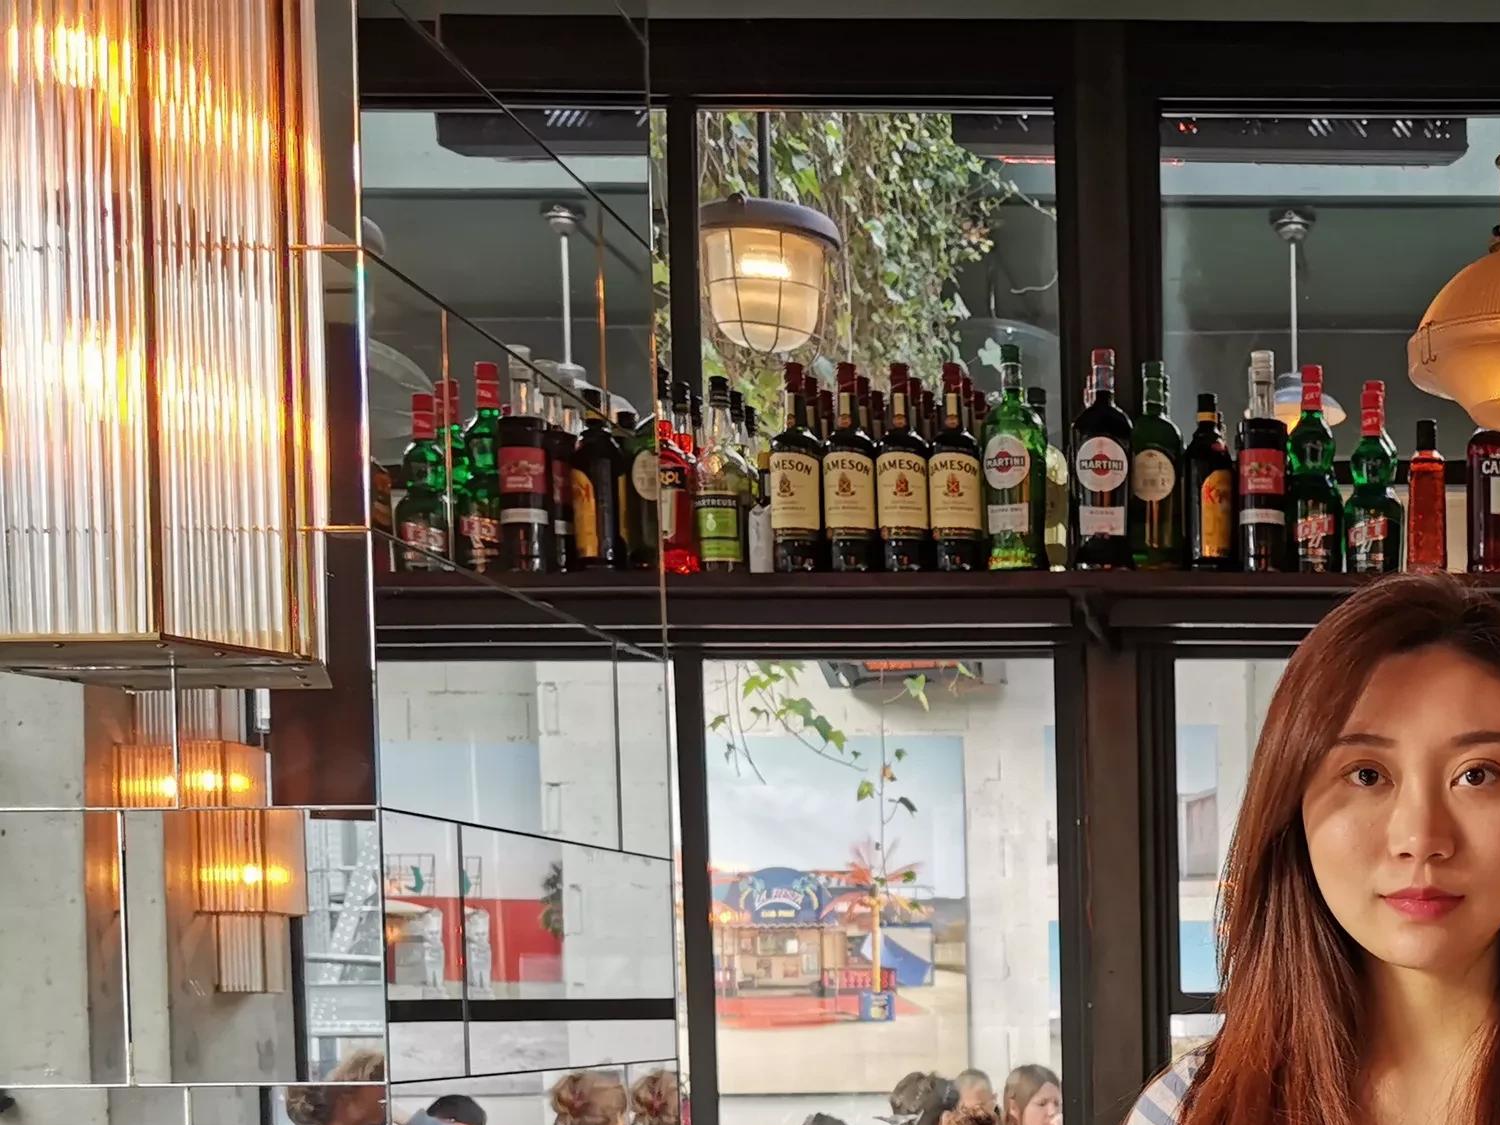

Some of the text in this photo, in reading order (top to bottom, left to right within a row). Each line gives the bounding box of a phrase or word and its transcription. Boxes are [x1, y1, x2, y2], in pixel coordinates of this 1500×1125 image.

[878, 459, 926, 477] JAMESON
[930, 459, 978, 477] JAMESON
[986, 456, 1025, 469] MARTINI
[1080, 460, 1123, 470] MARTINI
